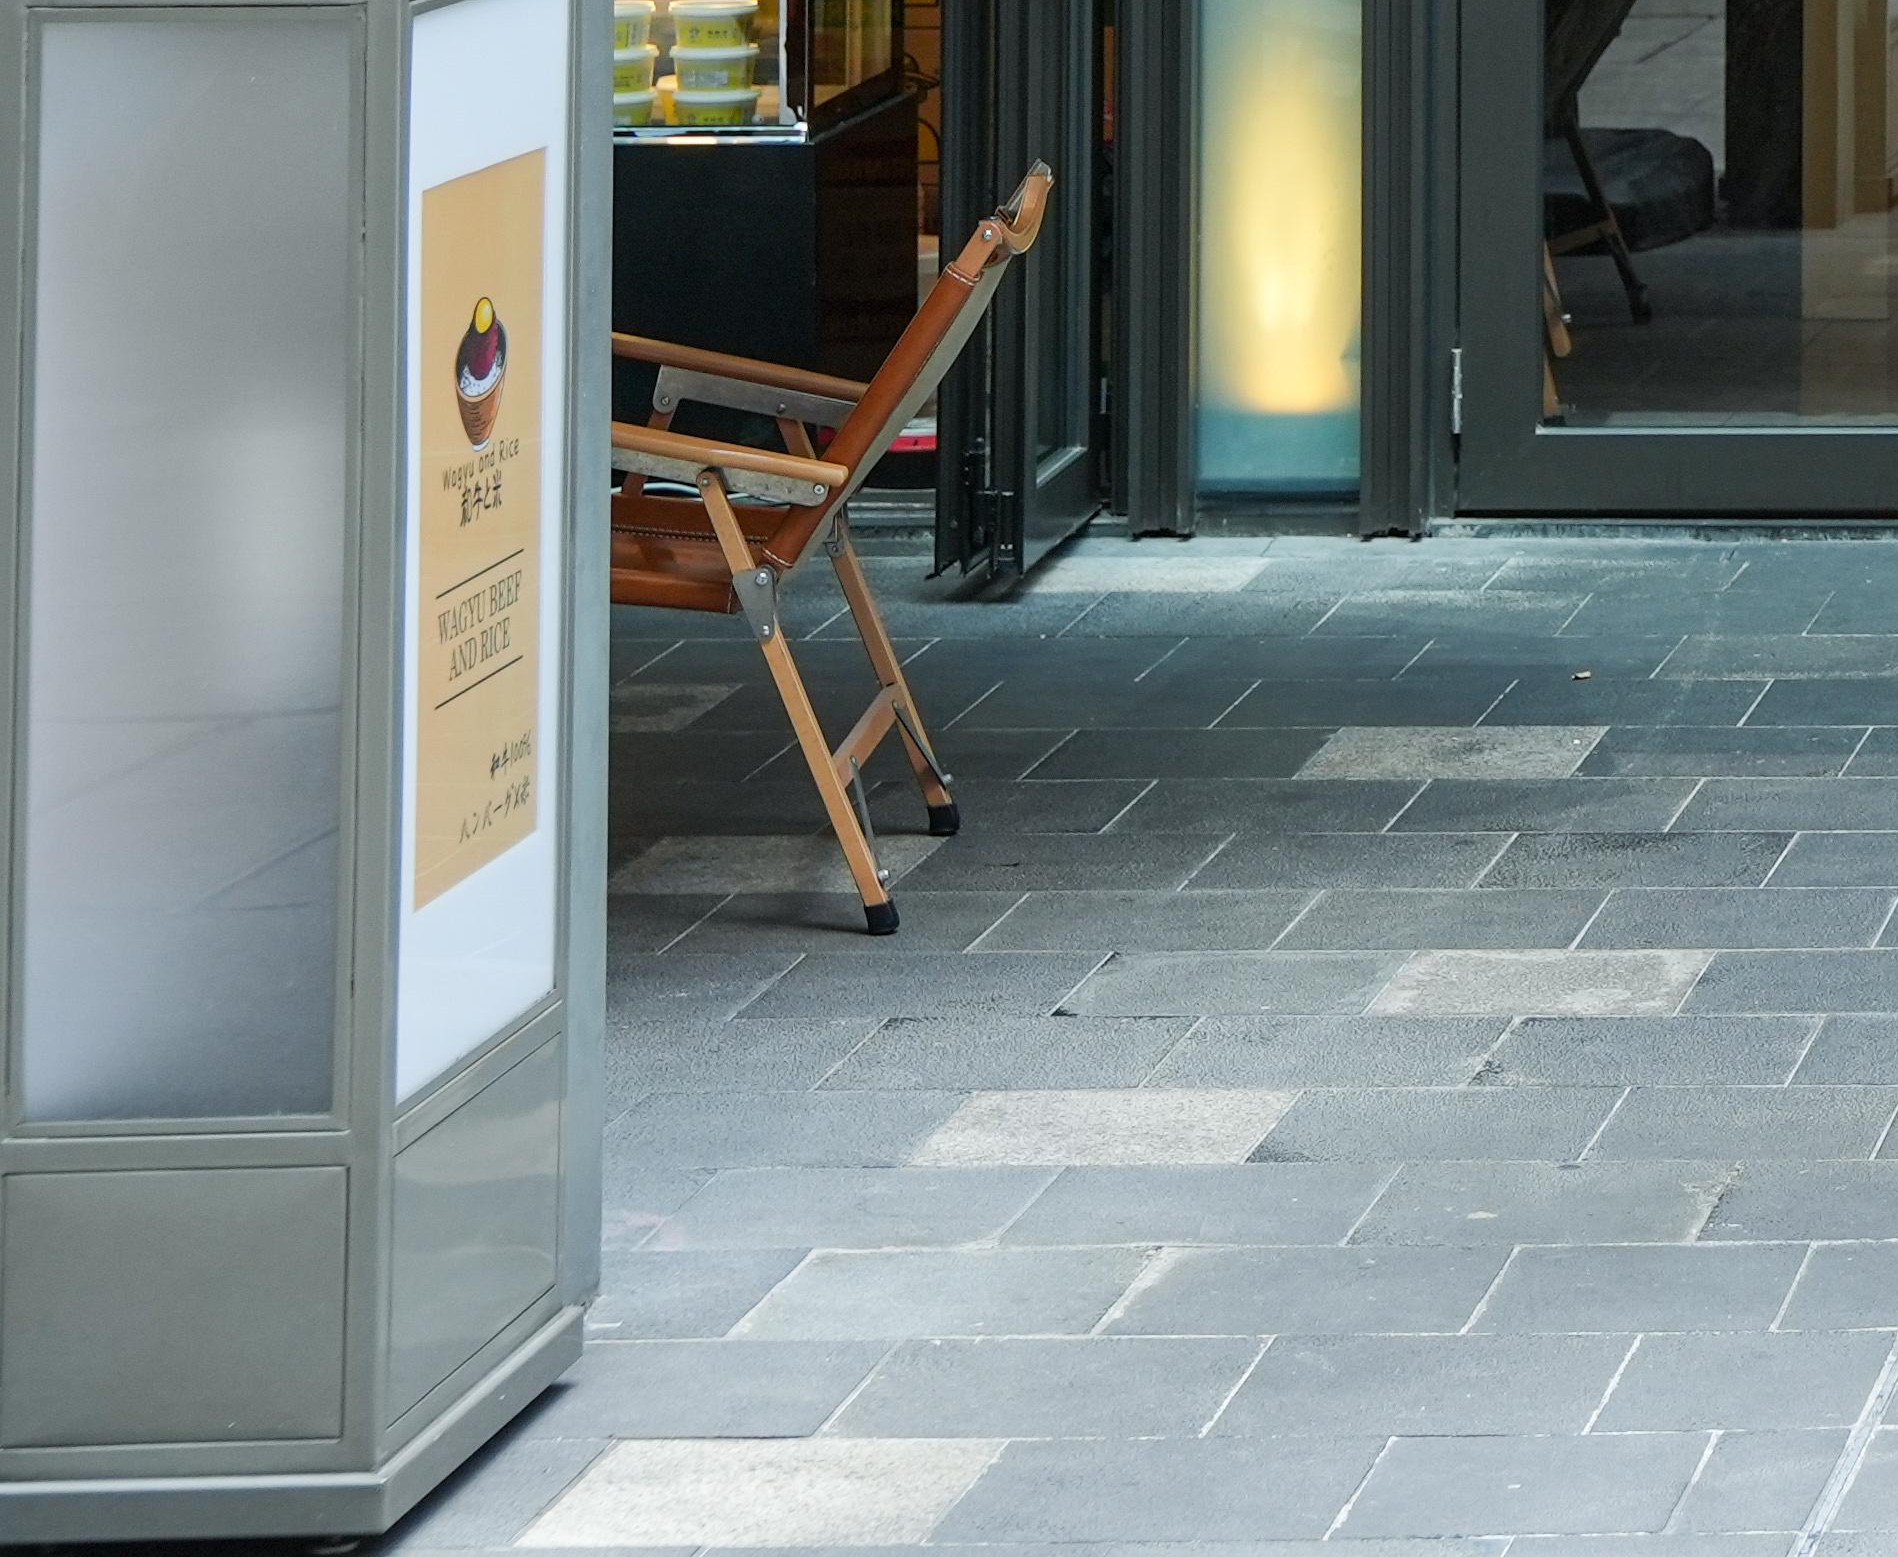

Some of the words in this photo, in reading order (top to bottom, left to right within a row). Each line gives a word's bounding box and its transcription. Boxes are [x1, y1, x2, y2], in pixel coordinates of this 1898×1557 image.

[441, 461, 474, 492] Wagyu
[479, 449, 496, 470] and
[499, 438, 520, 463] Rice
[460, 471, 503, 529] 和牛と米
[437, 585, 487, 646] WAGYU
[489, 569, 523, 626] BEEF
[448, 634, 479, 682] AND
[480, 616, 512, 665] RICE
